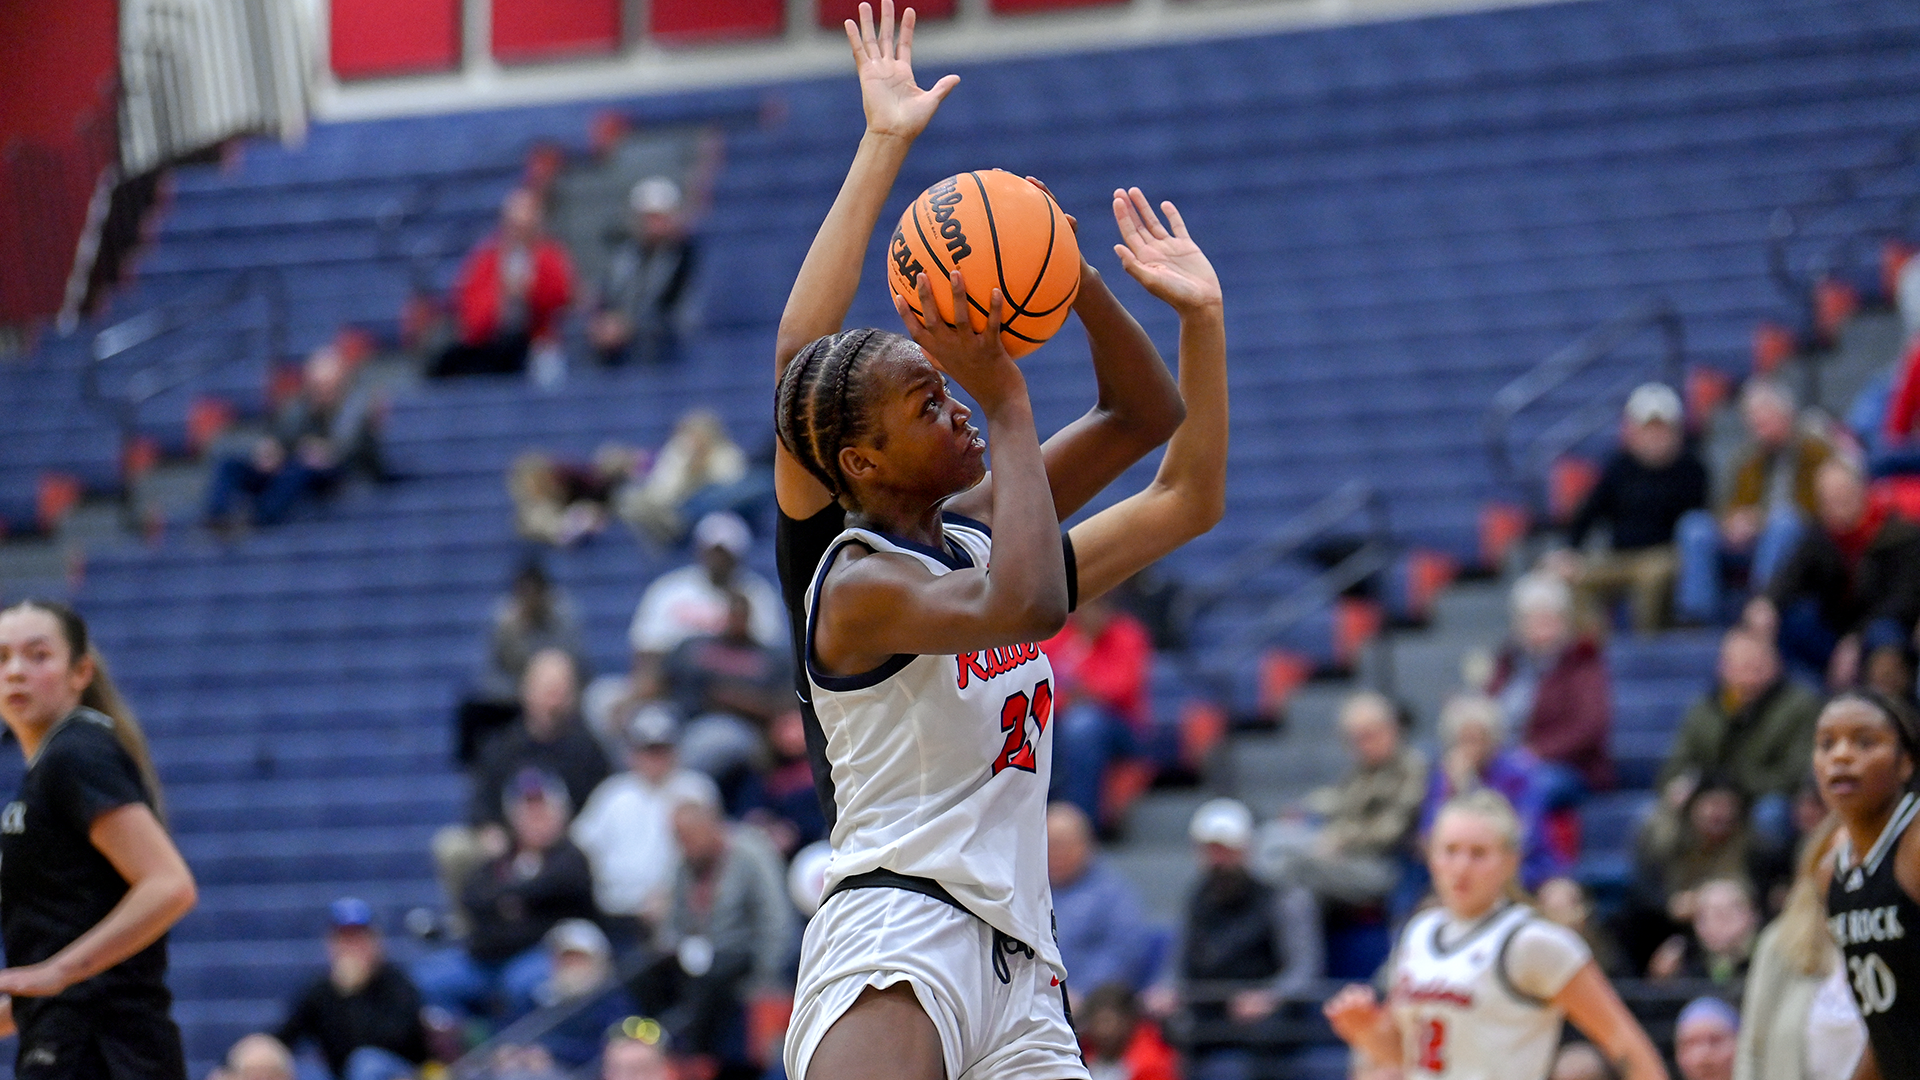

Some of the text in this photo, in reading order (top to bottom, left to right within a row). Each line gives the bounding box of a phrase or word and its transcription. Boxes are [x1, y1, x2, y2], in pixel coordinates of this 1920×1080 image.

[891, 222, 924, 290] CAA
[928, 174, 972, 266] Wilson
[992, 678, 1053, 778] 21
[1848, 952, 1897, 1016] 30
